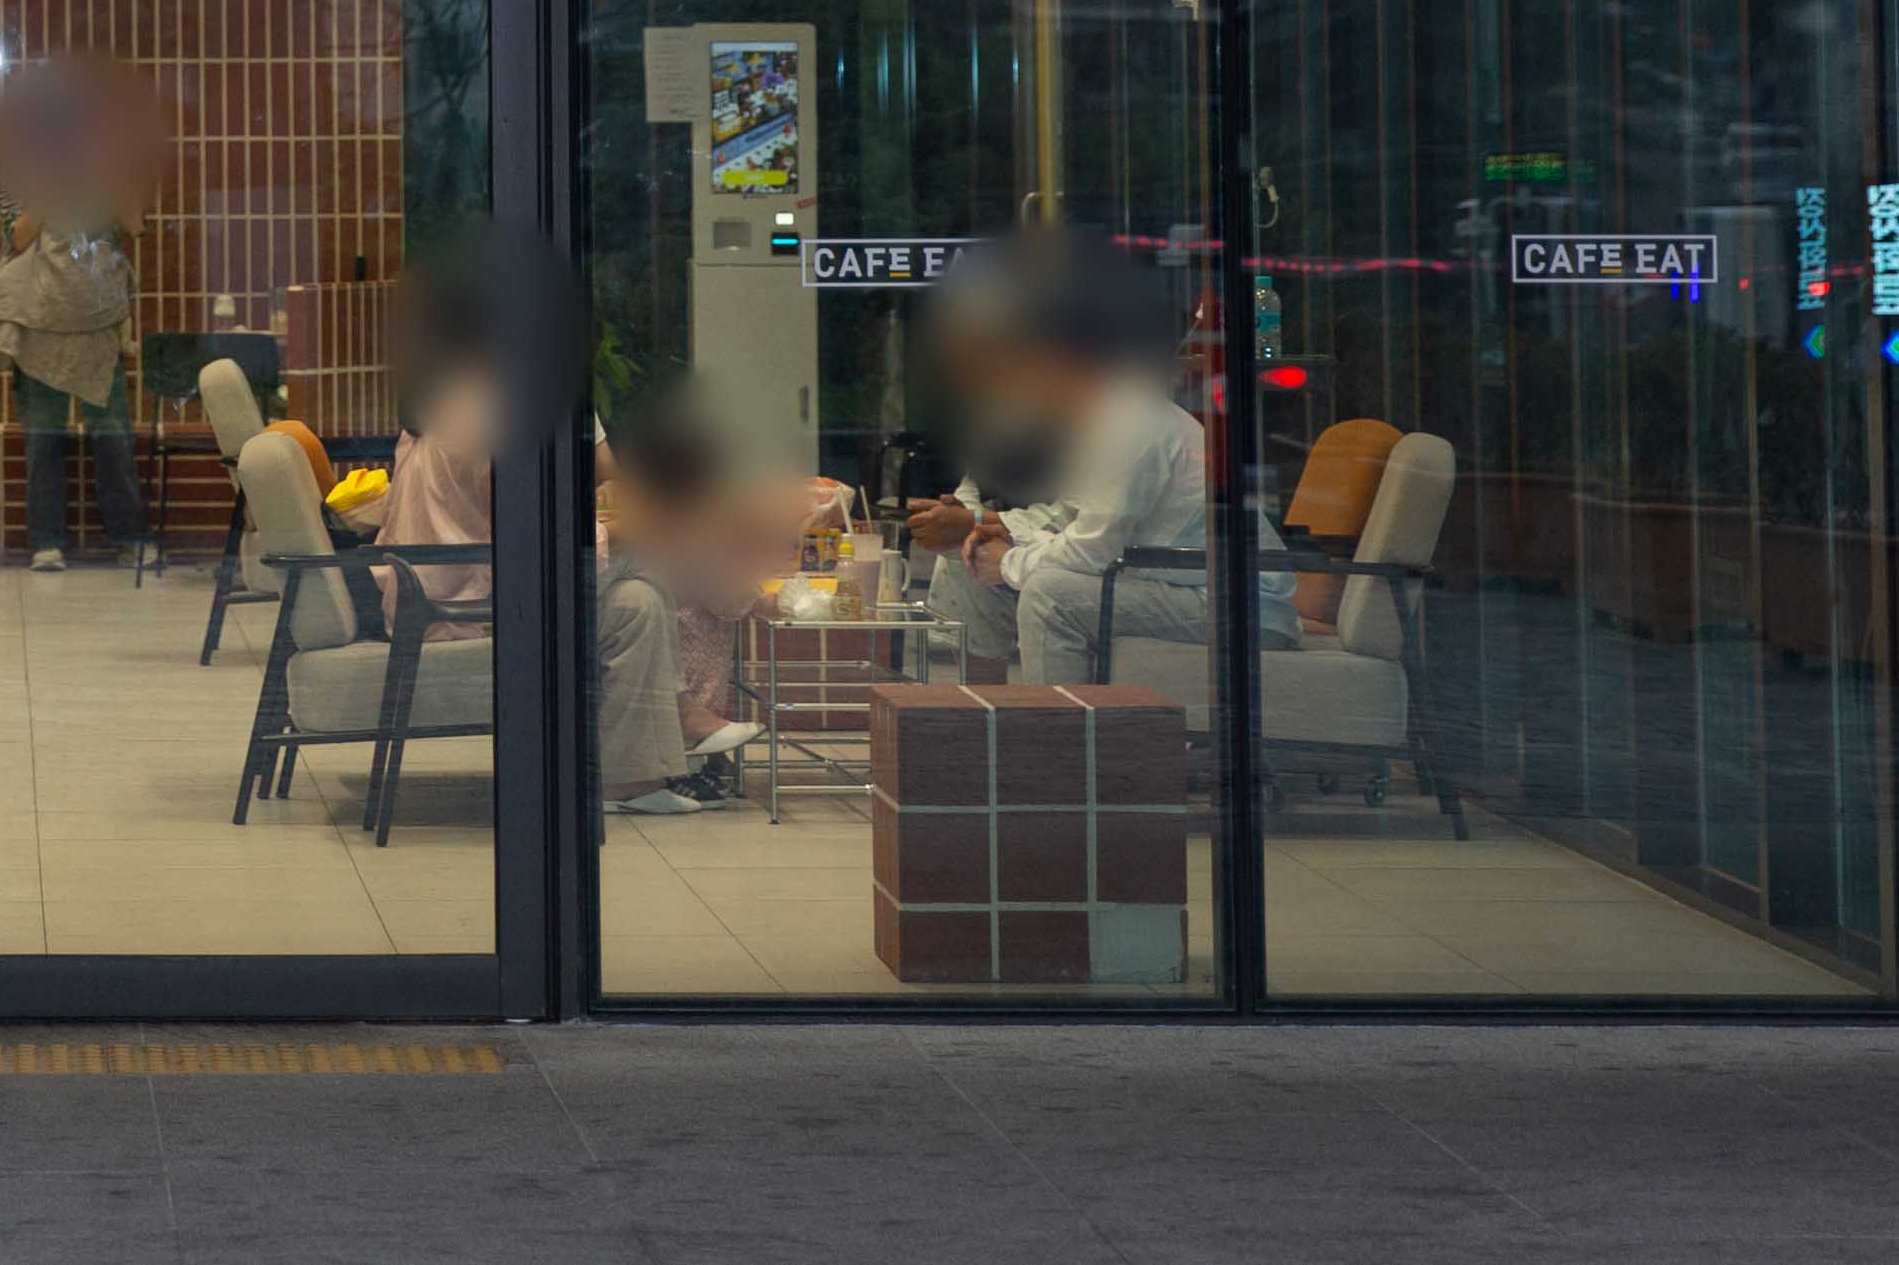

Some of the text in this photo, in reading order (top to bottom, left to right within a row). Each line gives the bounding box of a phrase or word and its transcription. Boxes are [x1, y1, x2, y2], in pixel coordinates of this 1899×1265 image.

[813, 248, 912, 278] CAFE
[1523, 243, 1705, 275] CAFE EAT
